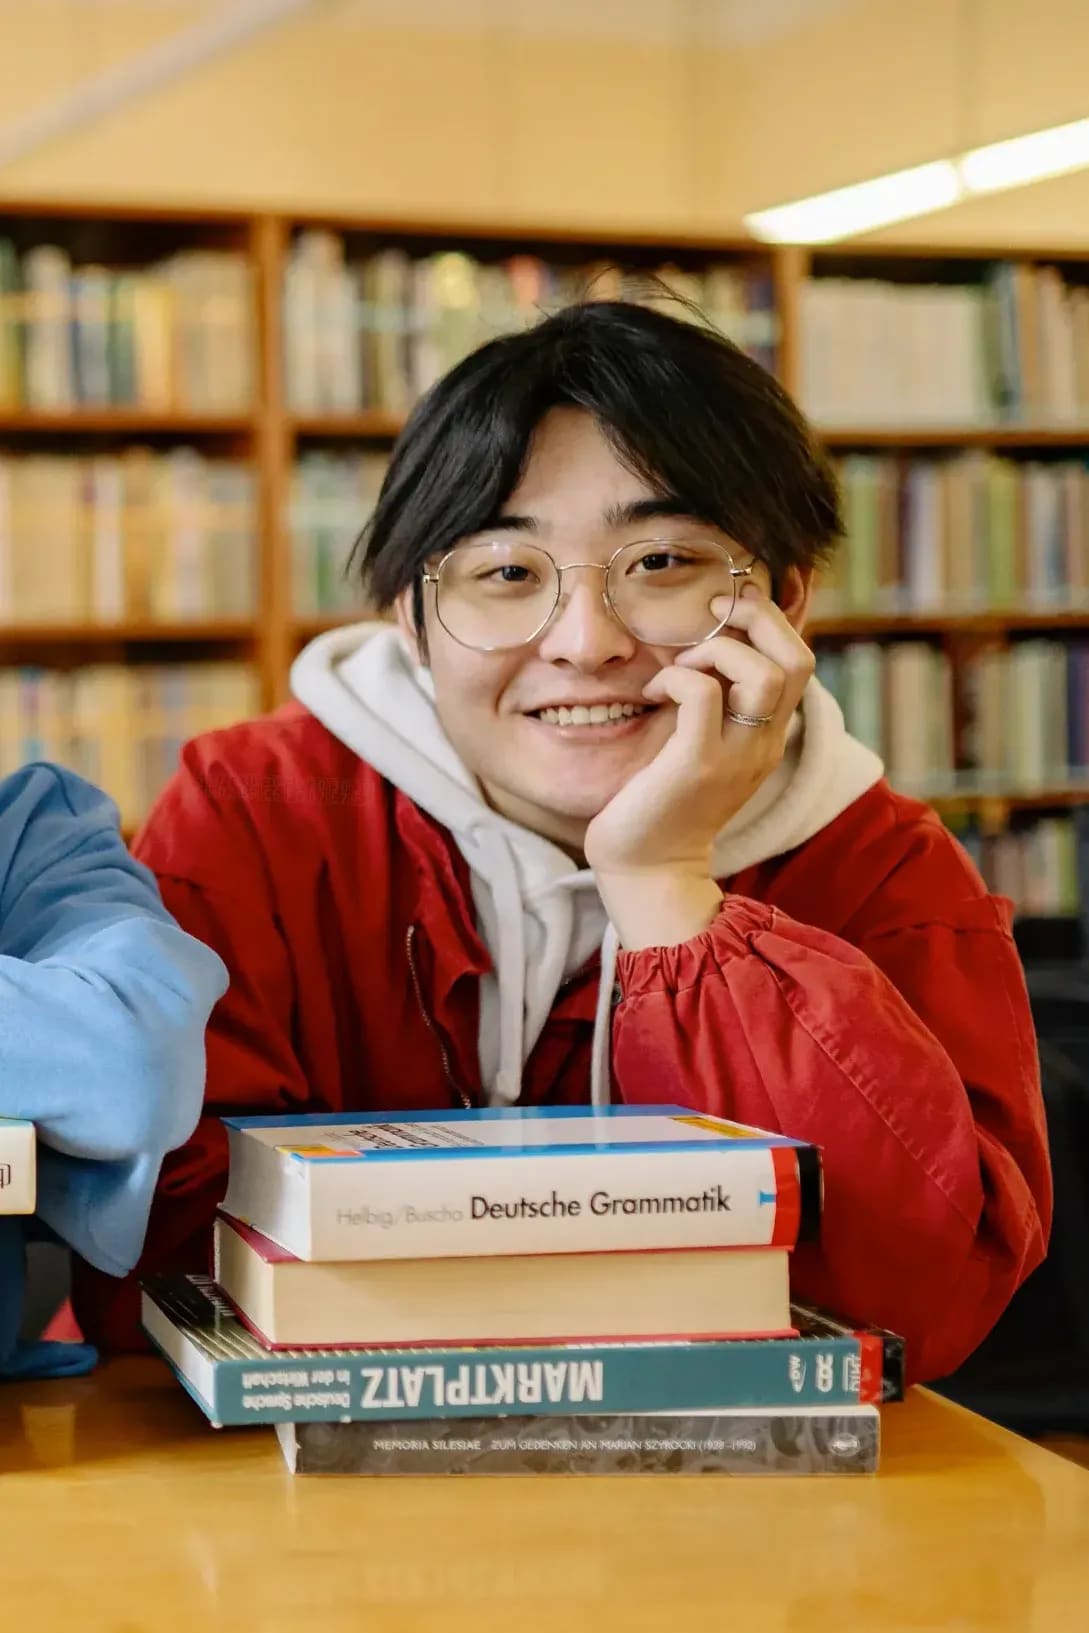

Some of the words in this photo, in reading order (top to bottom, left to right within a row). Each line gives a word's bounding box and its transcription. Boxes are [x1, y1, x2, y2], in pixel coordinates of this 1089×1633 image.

[471, 1191, 581, 1219] Deutsche
[590, 1185, 731, 1216] Grammatik
[311, 1370, 334, 1386] der
[360, 1361, 604, 1409] MARKTPLATZ
[373, 1439, 430, 1451] MEMORIA
[431, 1439, 481, 1451] SILESIAE
[491, 1439, 516, 1450] ZUM
[519, 1438, 578, 1450] GEDENKEN
[581, 1439, 597, 1450] AN
[600, 1439, 643, 1450] MARIAN
